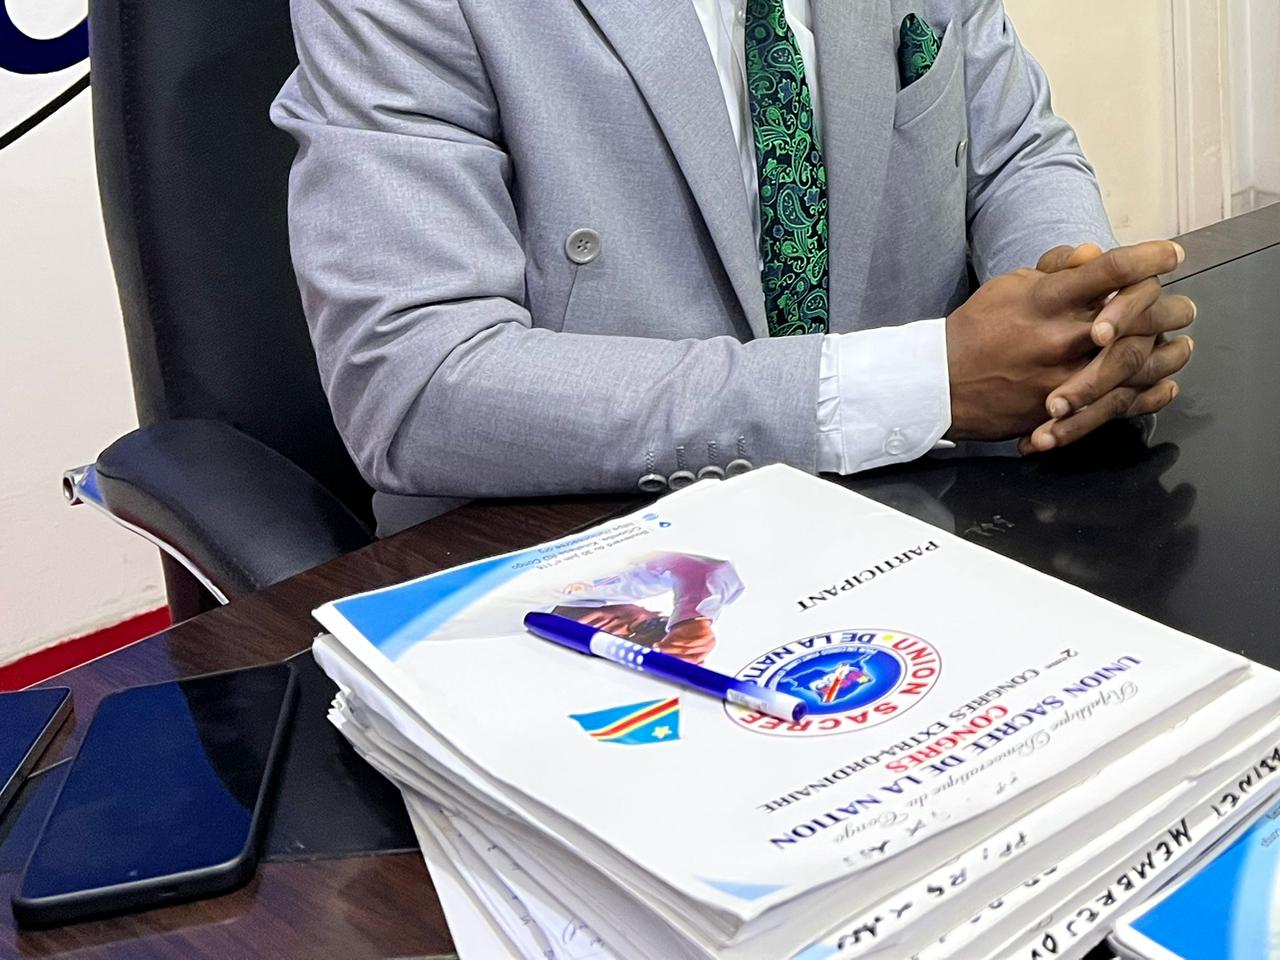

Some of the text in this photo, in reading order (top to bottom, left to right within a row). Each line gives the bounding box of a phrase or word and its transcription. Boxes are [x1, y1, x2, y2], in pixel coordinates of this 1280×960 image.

[797, 541, 940, 612] PARTICIPANT
[743, 632, 877, 688] DE LA NATI
[891, 637, 937, 696] UNION
[1062, 655, 1142, 697] UNION
[739, 701, 899, 731] SACREE
[949, 668, 1040, 721] CONGRES
[885, 705, 1009, 773] CONGRES
[961, 696, 1065, 755] SACREE
[755, 721, 949, 814] EXTRA-ORDINAIRE
[881, 775, 922, 794] LA
[921, 754, 966, 777] DE
[769, 794, 883, 850] NATION
